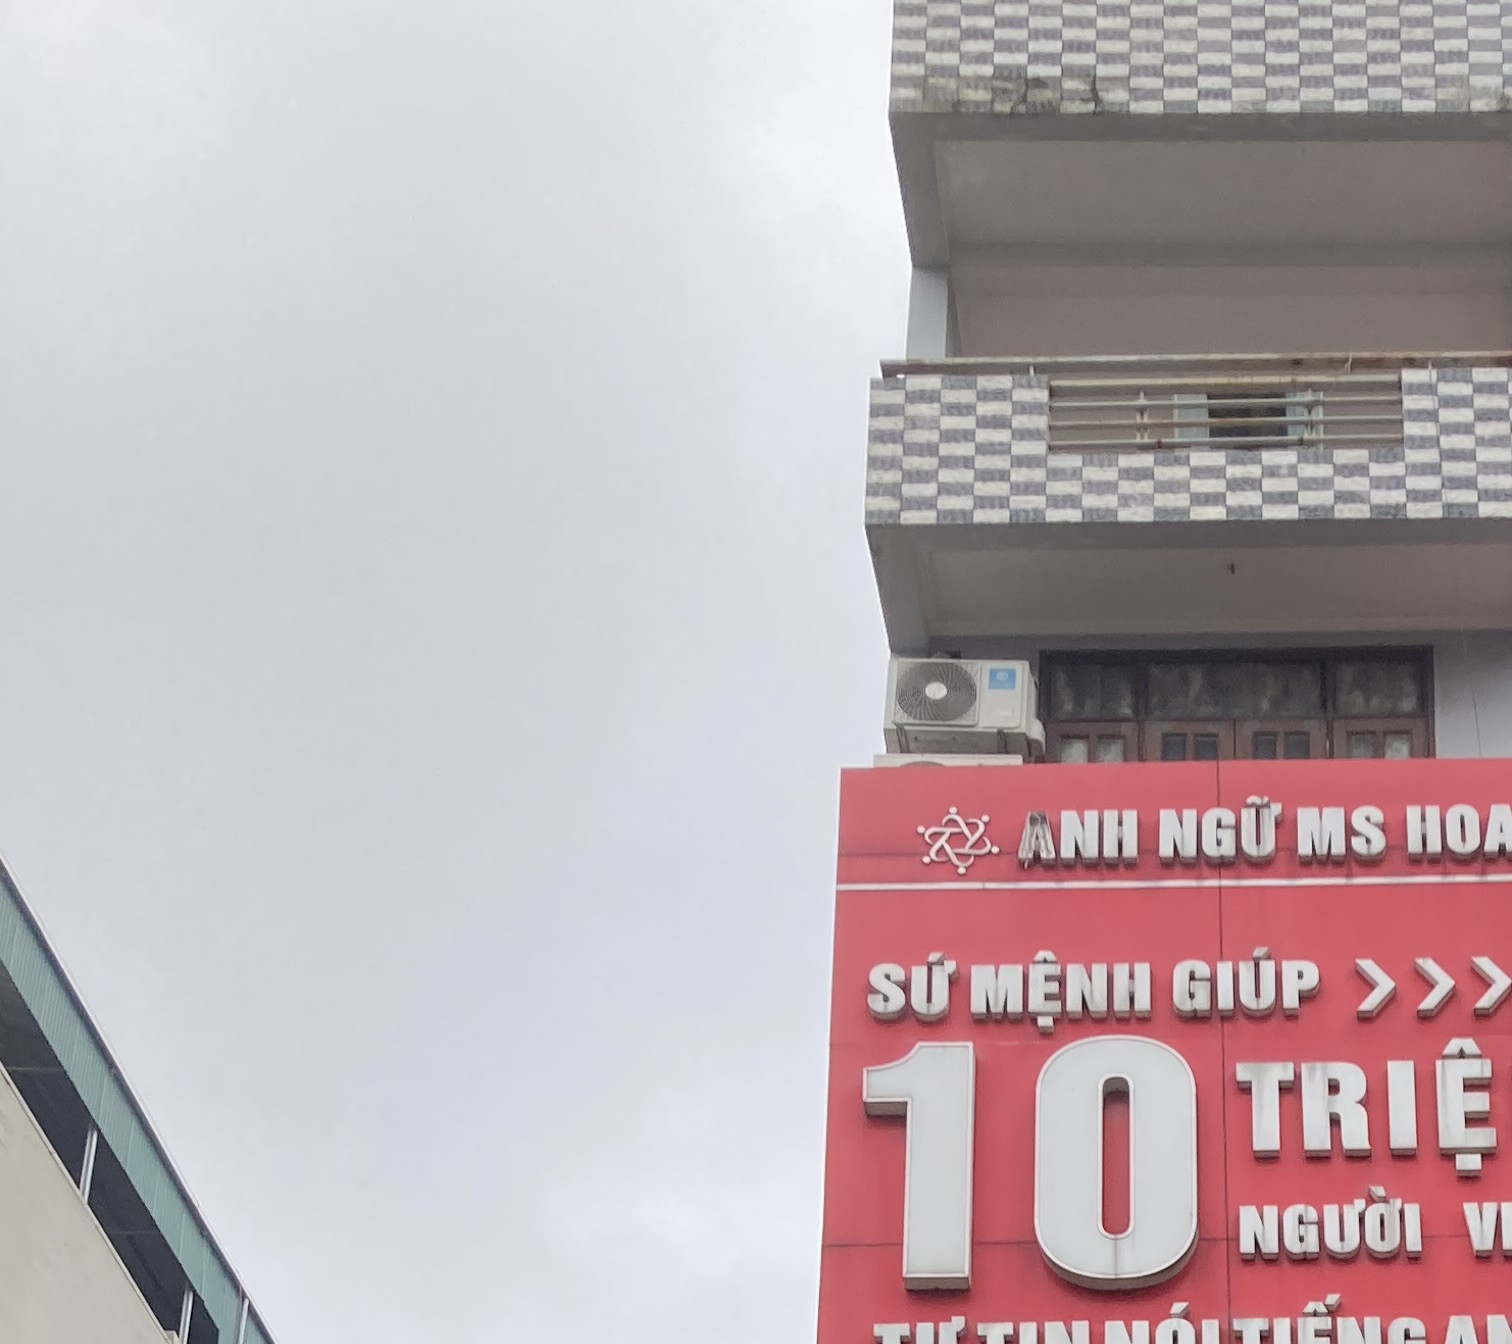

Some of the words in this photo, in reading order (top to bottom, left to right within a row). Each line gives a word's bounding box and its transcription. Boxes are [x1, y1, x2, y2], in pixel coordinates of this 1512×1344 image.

[1018, 806, 1139, 868] ANH
[1158, 794, 1283, 866] NGỮ
[1297, 806, 1386, 863] MS
[866, 951, 959, 1021] SỨ
[970, 950, 1153, 1032] MỆNH
[1172, 947, 1321, 1019] GIÚP
[861, 1034, 1199, 1290] 10
[1239, 1185, 1422, 1260] NGƯỜI
